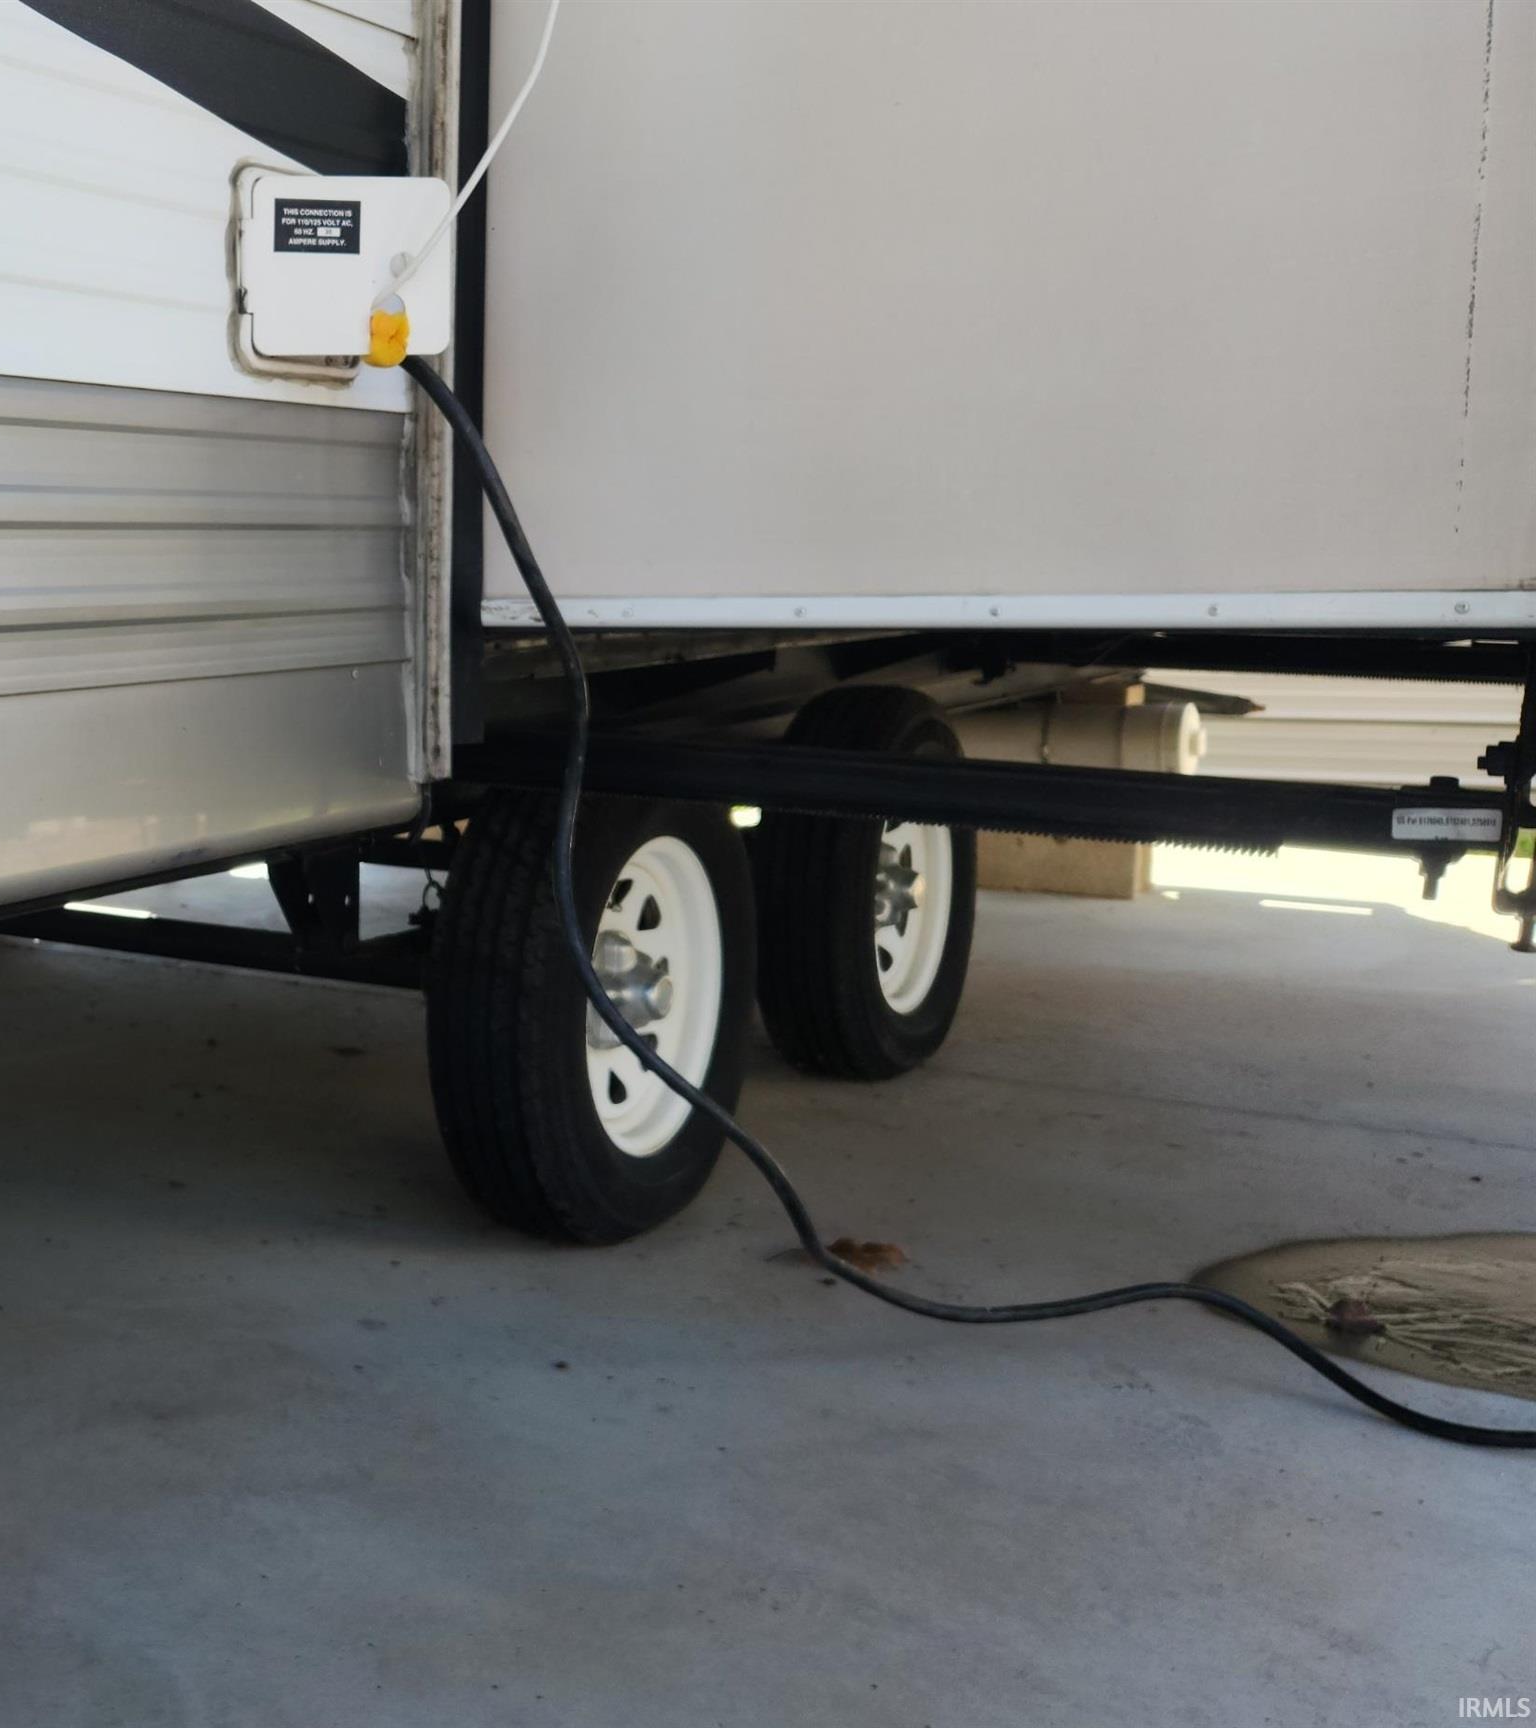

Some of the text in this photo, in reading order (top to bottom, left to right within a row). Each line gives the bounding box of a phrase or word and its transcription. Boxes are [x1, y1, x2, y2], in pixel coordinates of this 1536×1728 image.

[283, 208, 298, 216] THIS
[300, 209, 344, 217] CONNECTION
[288, 238, 347, 246] AMPERE SUPPLY.
